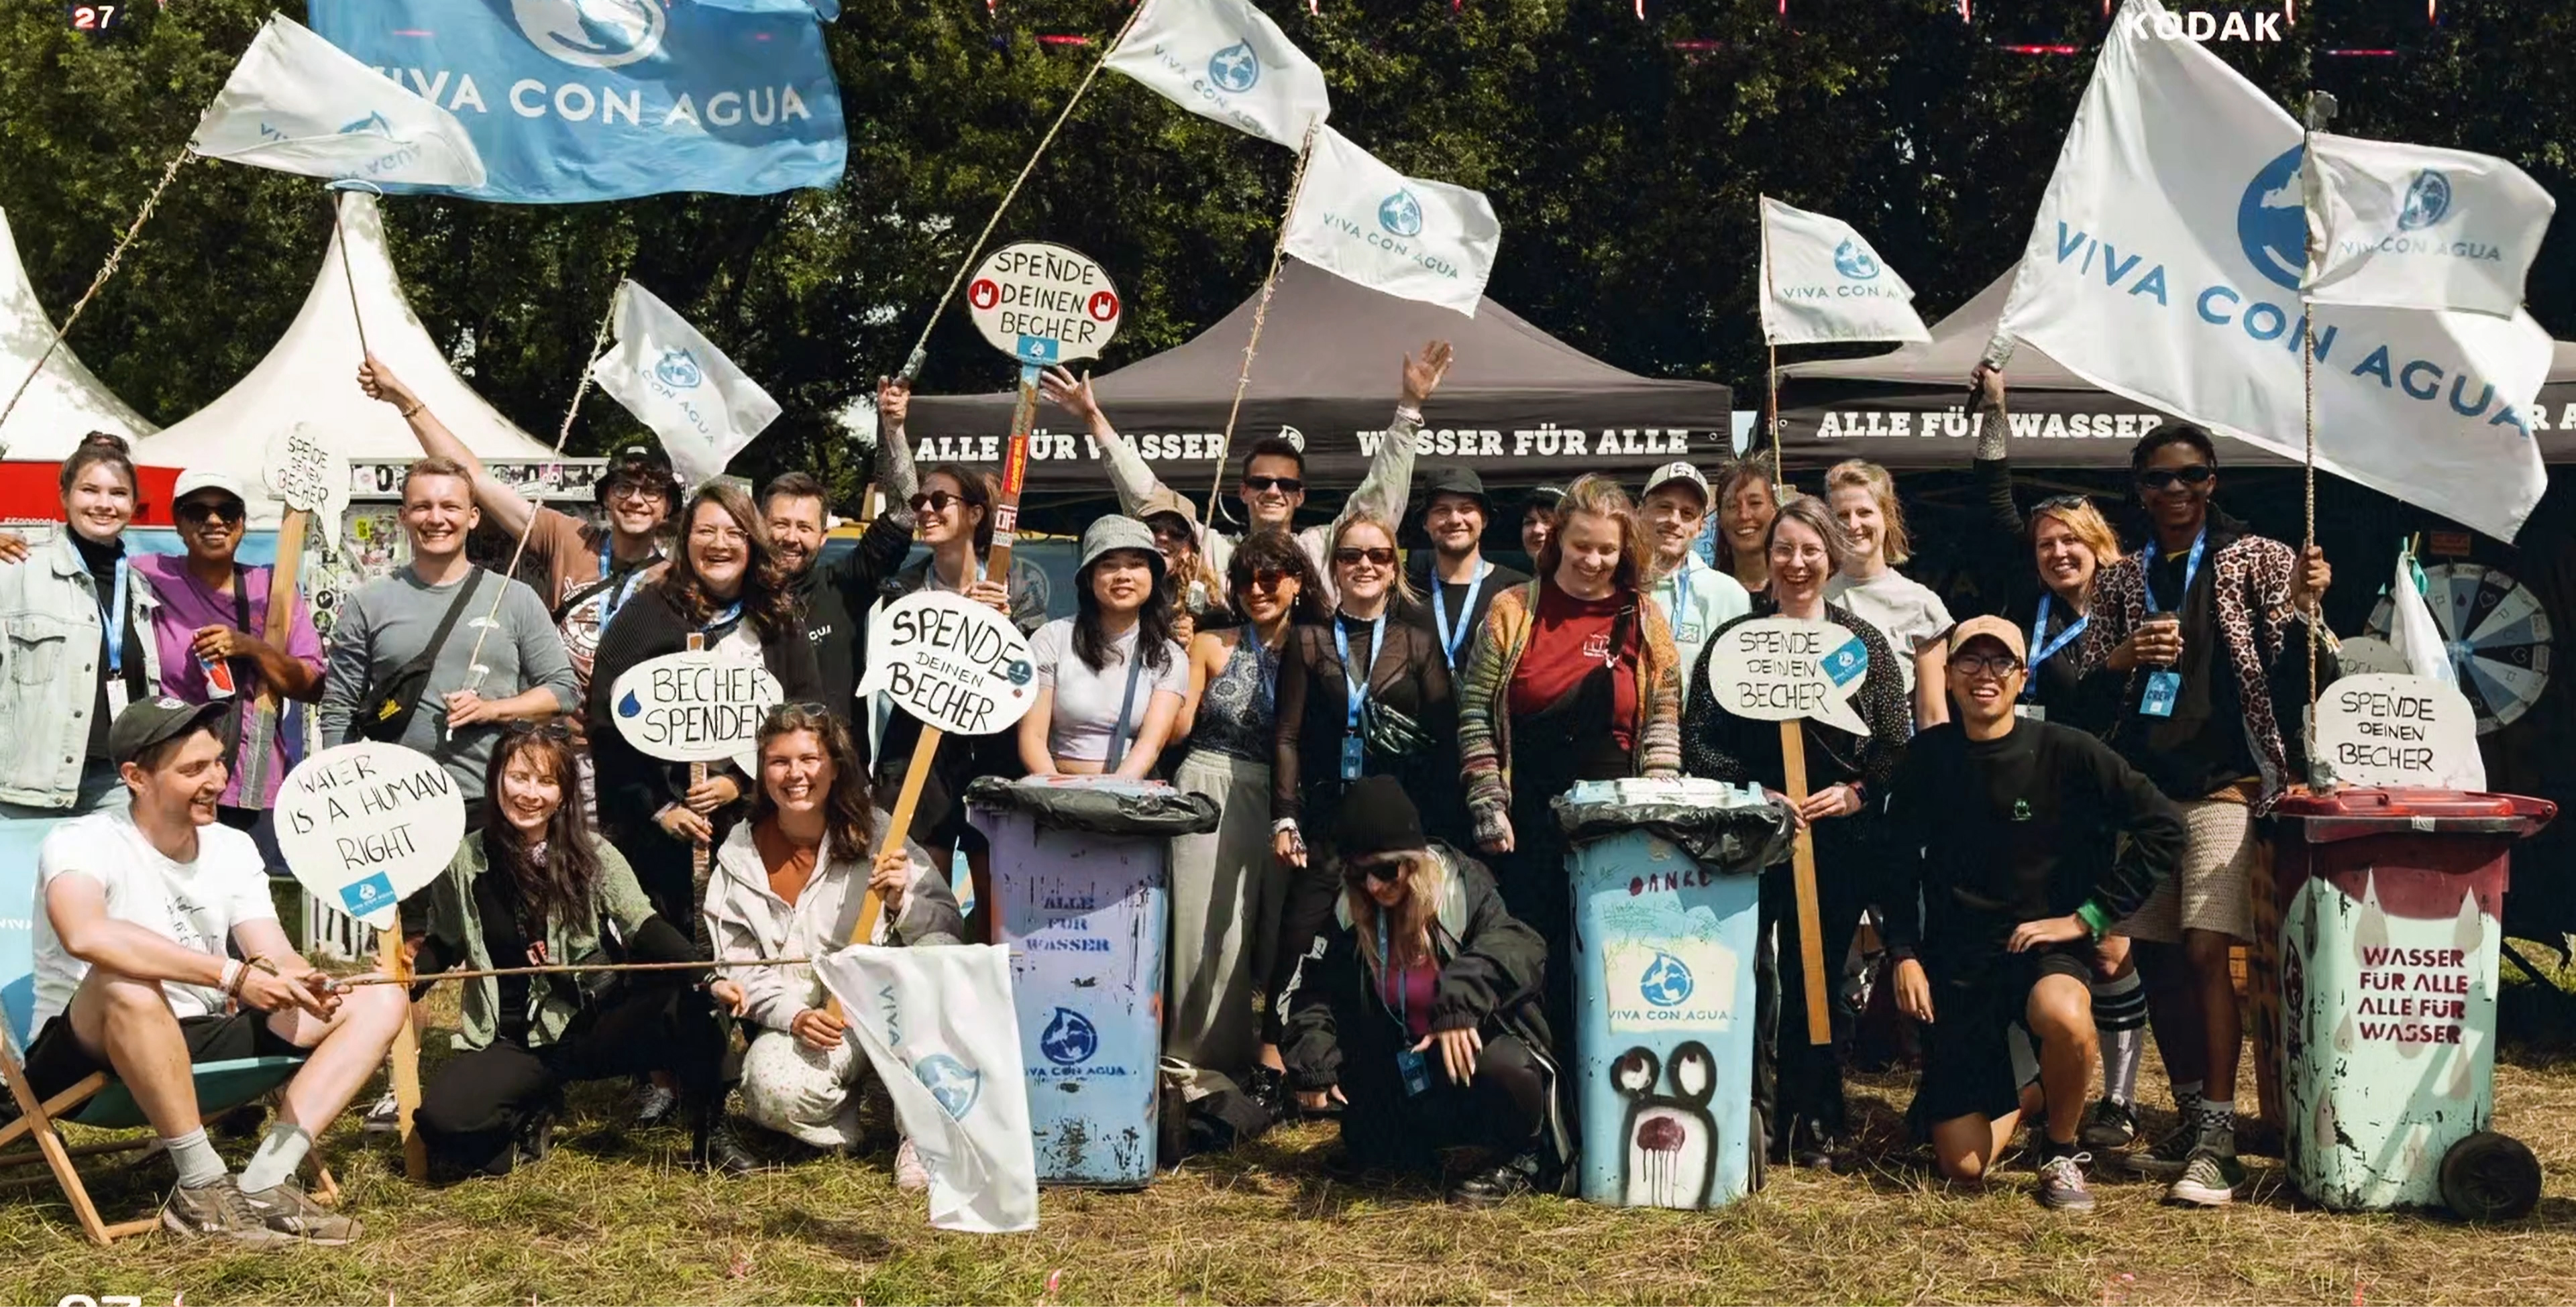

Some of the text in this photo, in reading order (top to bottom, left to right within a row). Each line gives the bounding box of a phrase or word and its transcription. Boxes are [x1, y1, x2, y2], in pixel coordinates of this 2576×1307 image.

[508, 78, 641, 126] CON
[665, 84, 812, 127] AGUA
[1324, 213, 1458, 279] VIVA CON AGUA
[2381, 236, 2427, 253] CON
[2433, 242, 2502, 262] AGUA
[1000, 282, 1085, 315] DEINEN
[1783, 286, 1829, 298] VIVA
[1837, 286, 1879, 297] CON
[1000, 311, 1096, 343] BECHER
[2057, 220, 2531, 439] VIVA CON AGUA
[641, 370, 715, 448] CON AGUA
[1816, 411, 1911, 438] ALLE
[914, 437, 999, 461] ALLE
[1008, 429, 1077, 461] ÜR
[1356, 422, 1689, 457] WSSER FÜR ALLE
[891, 607, 1028, 682] SPENDE
[1739, 630, 1822, 655] SPENDE
[915, 650, 985, 687] DEINEN
[1746, 658, 1817, 678] DEINEN
[652, 665, 771, 703] BECHER
[886, 661, 994, 733] BECHER
[1736, 681, 1829, 714] BECHER
[2341, 691, 2436, 722] SPENDE
[2357, 722, 2426, 742] DEINEN
[2337, 742, 2434, 773] BECHER
[297, 754, 377, 793] WATER
[289, 767, 449, 835] IS A HUMAN
[336, 822, 415, 870] RIGHT
[1044, 897, 1095, 909] ALLE
[1026, 939, 1110, 952] WASSER
[2363, 946, 2465, 968] WASSER
[2359, 972, 2468, 994] FÜR ALLE
[1646, 1010, 1680, 1021] CON
[1686, 1010, 1729, 1021] AGUA
[2357, 997, 2465, 1019] ALLE FÜR
[2359, 1022, 2461, 1044] WASSER
[1085, 1066, 1126, 1075] AGUA
